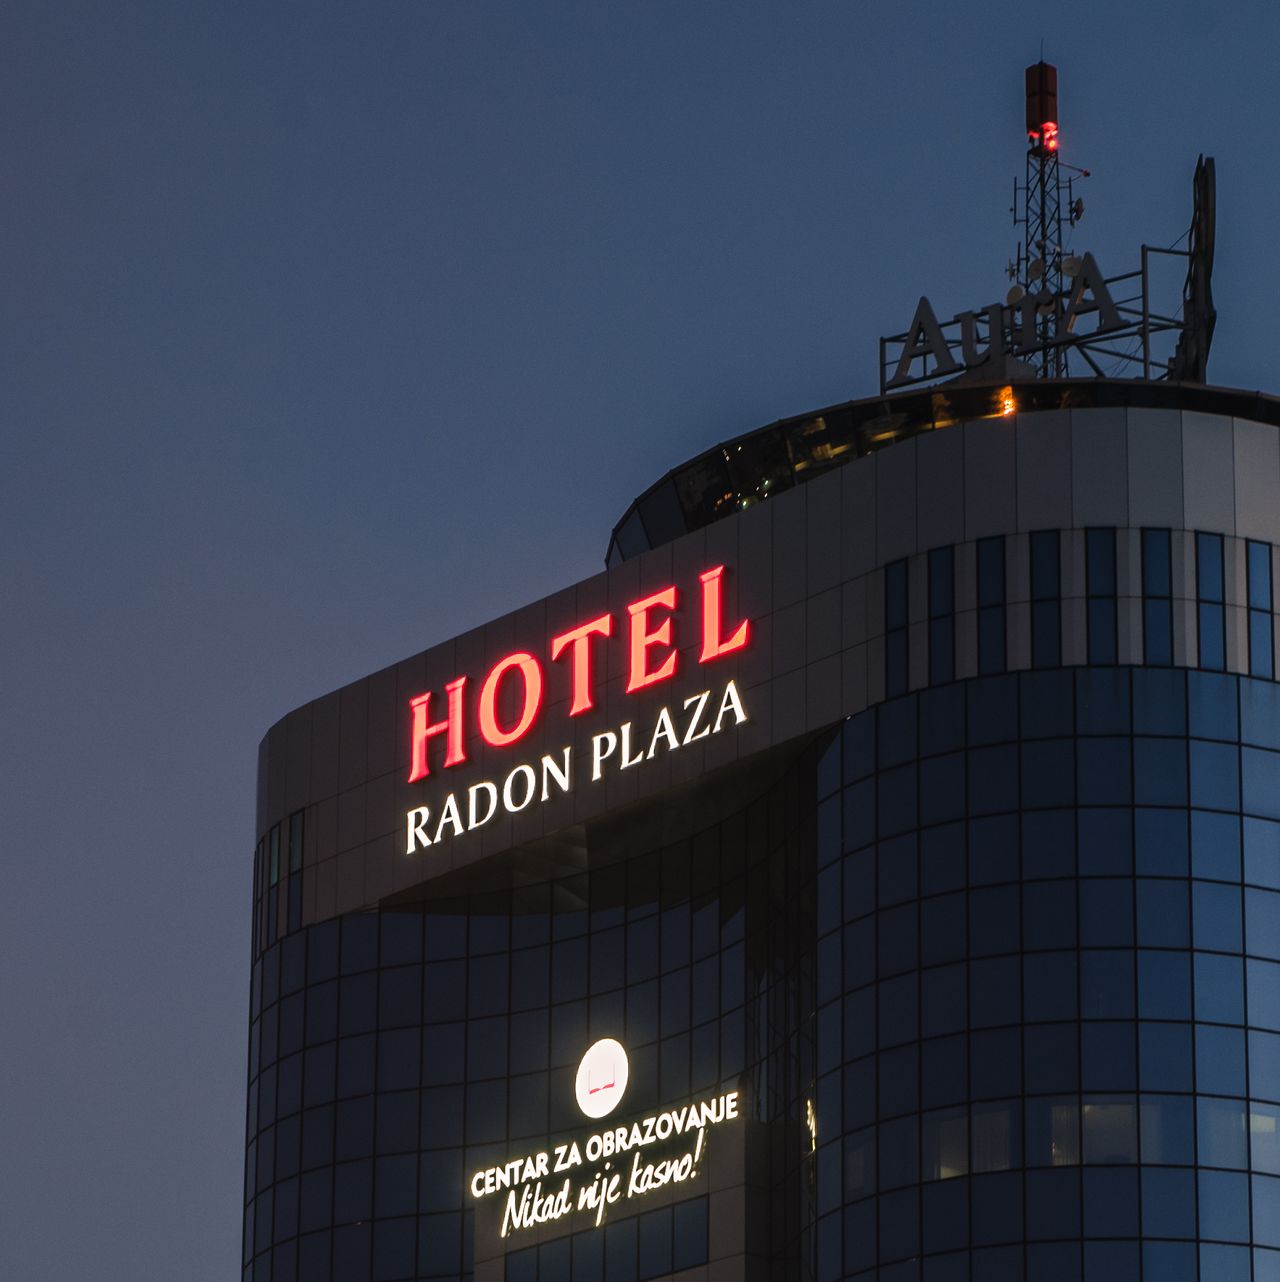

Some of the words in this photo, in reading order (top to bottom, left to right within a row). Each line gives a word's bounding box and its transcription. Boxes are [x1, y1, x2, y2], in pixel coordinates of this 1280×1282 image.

[407, 564, 750, 784] HOTEL
[405, 746, 572, 855] RADON
[591, 679, 749, 782] PLAZA
[470, 1152, 549, 1198] CENTAR
[553, 1141, 582, 1173] ZA
[585, 1091, 739, 1162] OBRAZOVANJE
[500, 1179, 572, 1238] Nikad
[578, 1162, 621, 1227] nije
[627, 1127, 705, 1198] kasno!
